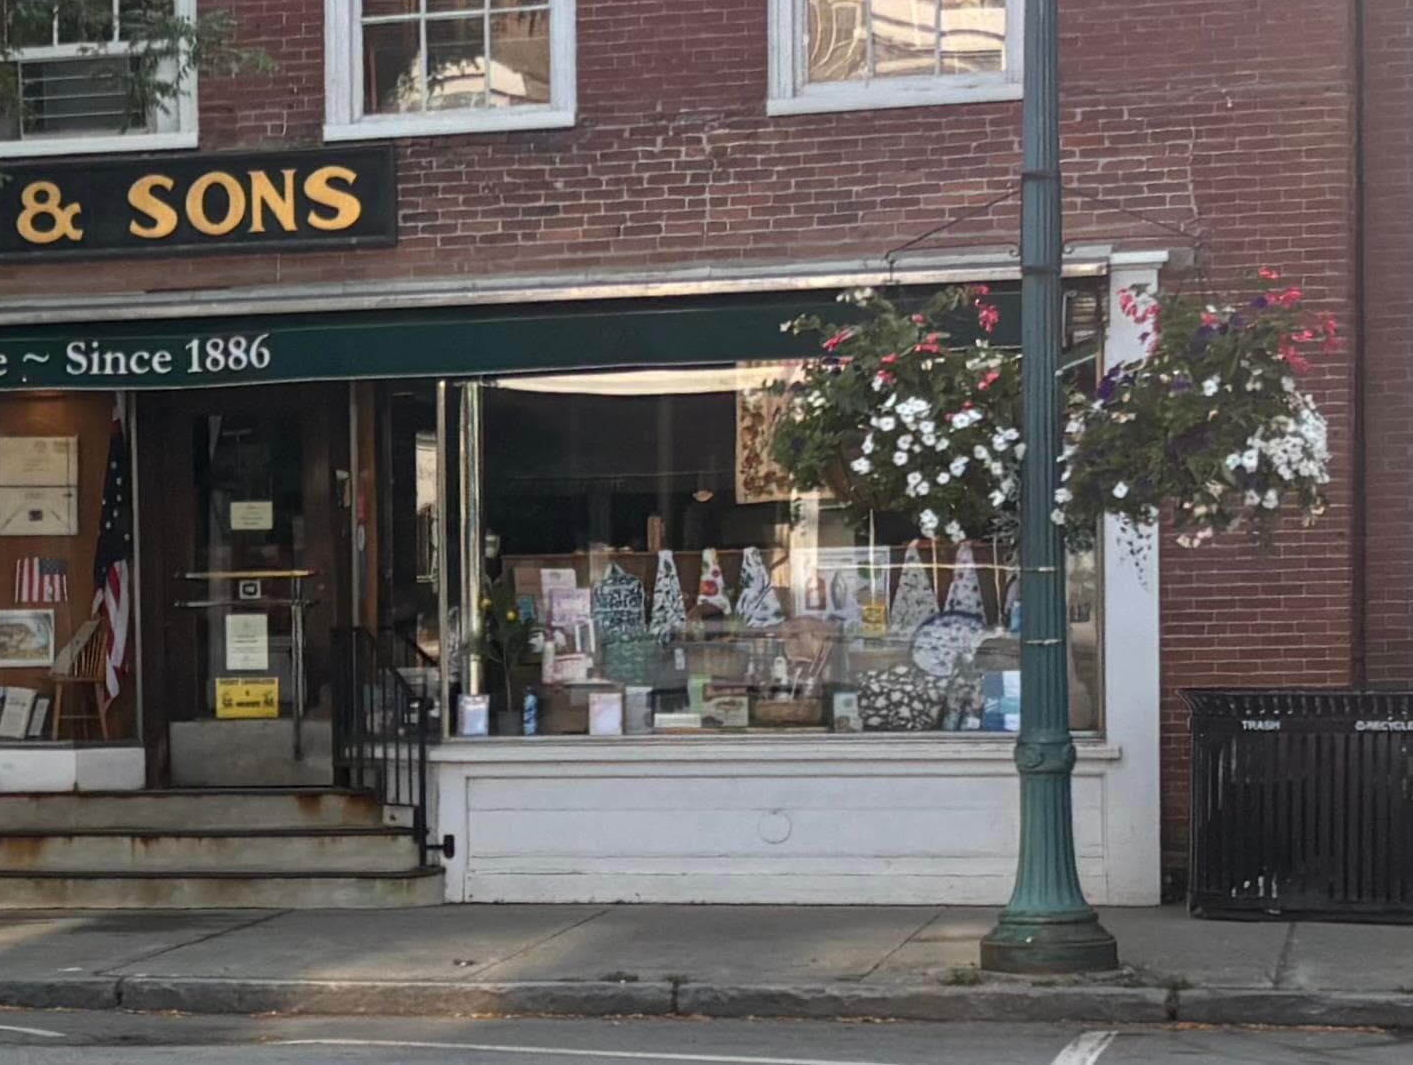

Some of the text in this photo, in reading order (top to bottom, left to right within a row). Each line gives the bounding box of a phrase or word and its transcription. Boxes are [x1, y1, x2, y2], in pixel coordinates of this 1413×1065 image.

[17, 181, 84, 245] &
[127, 167, 363, 239] SONS
[66, 341, 174, 376] Since
[184, 333, 271, 373] 1886
[1241, 720, 1282, 731] TRASH
